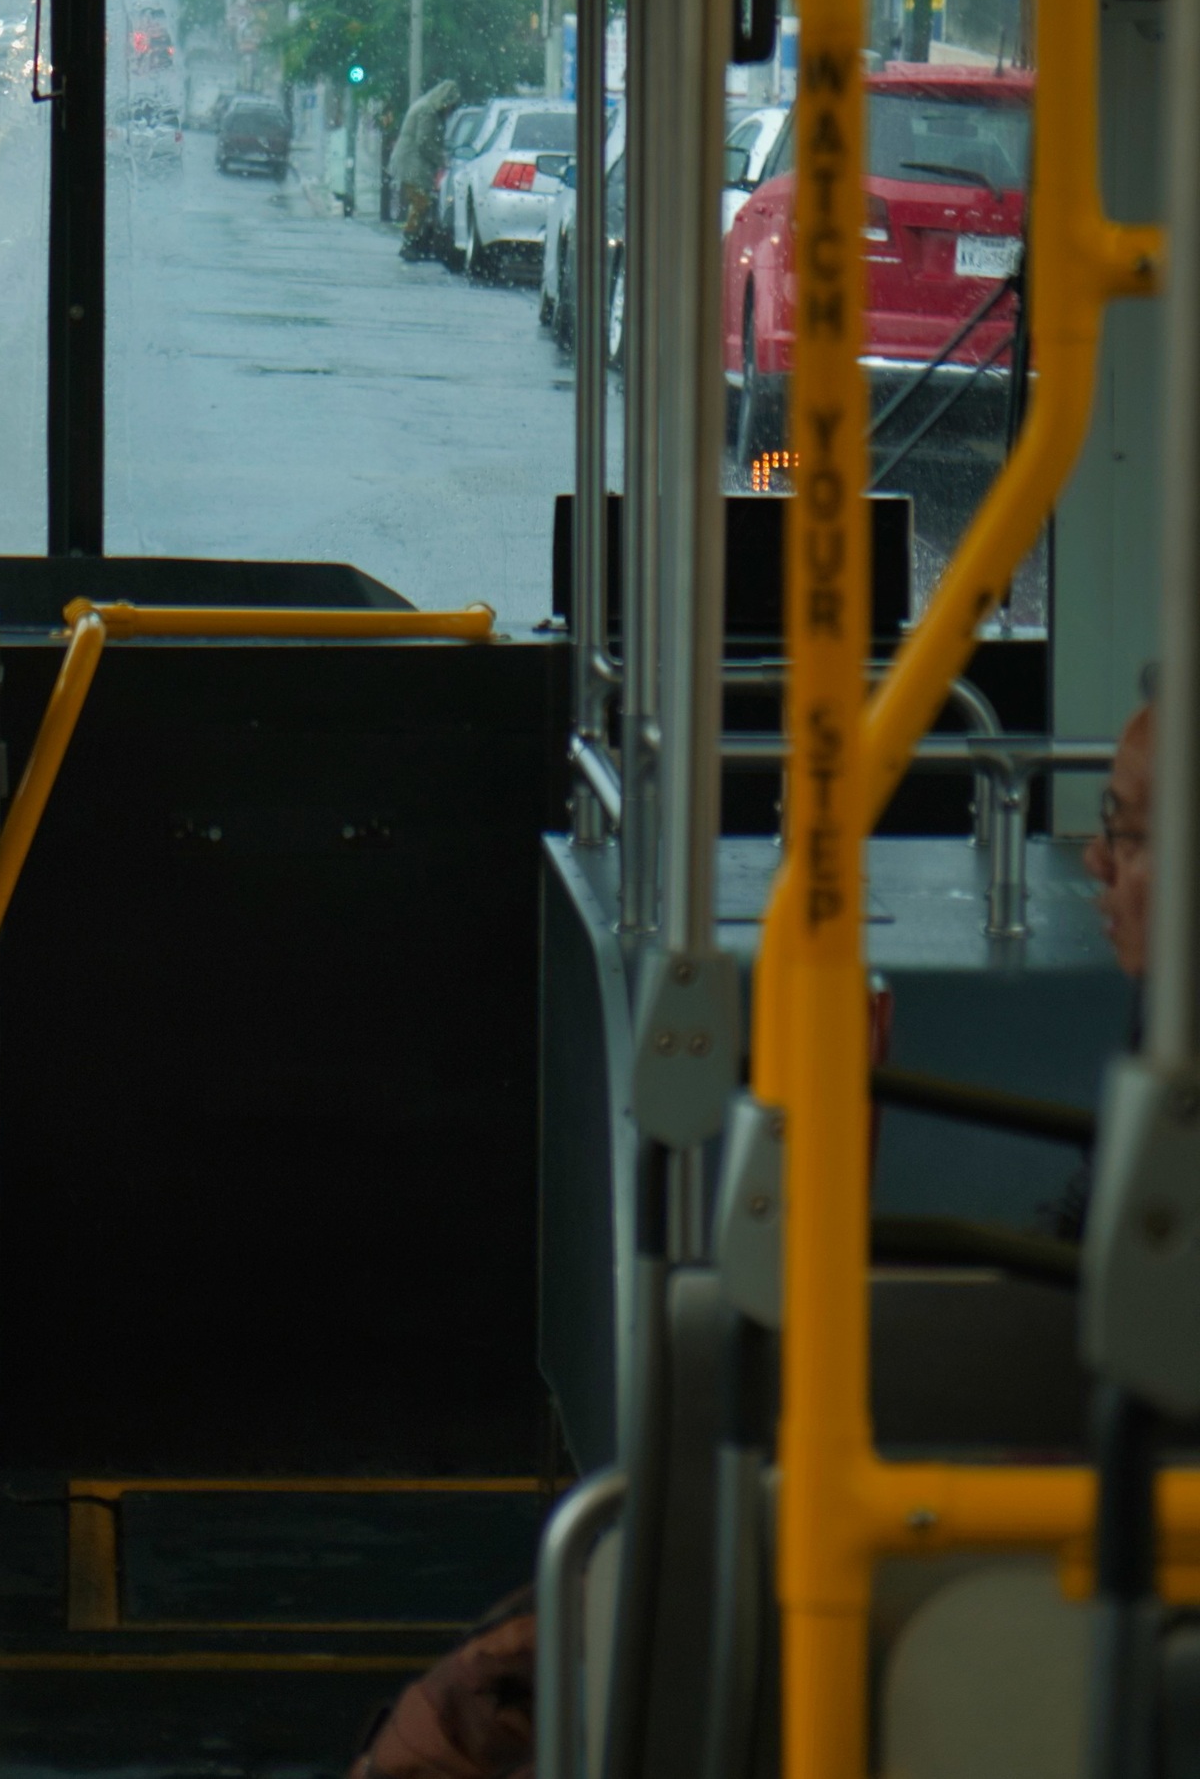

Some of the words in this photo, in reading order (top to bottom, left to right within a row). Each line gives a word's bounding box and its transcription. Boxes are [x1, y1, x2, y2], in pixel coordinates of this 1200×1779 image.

[804, 50, 846, 343] WATCH
[807, 409, 847, 639] YOUR
[809, 709, 847, 937] STEP
